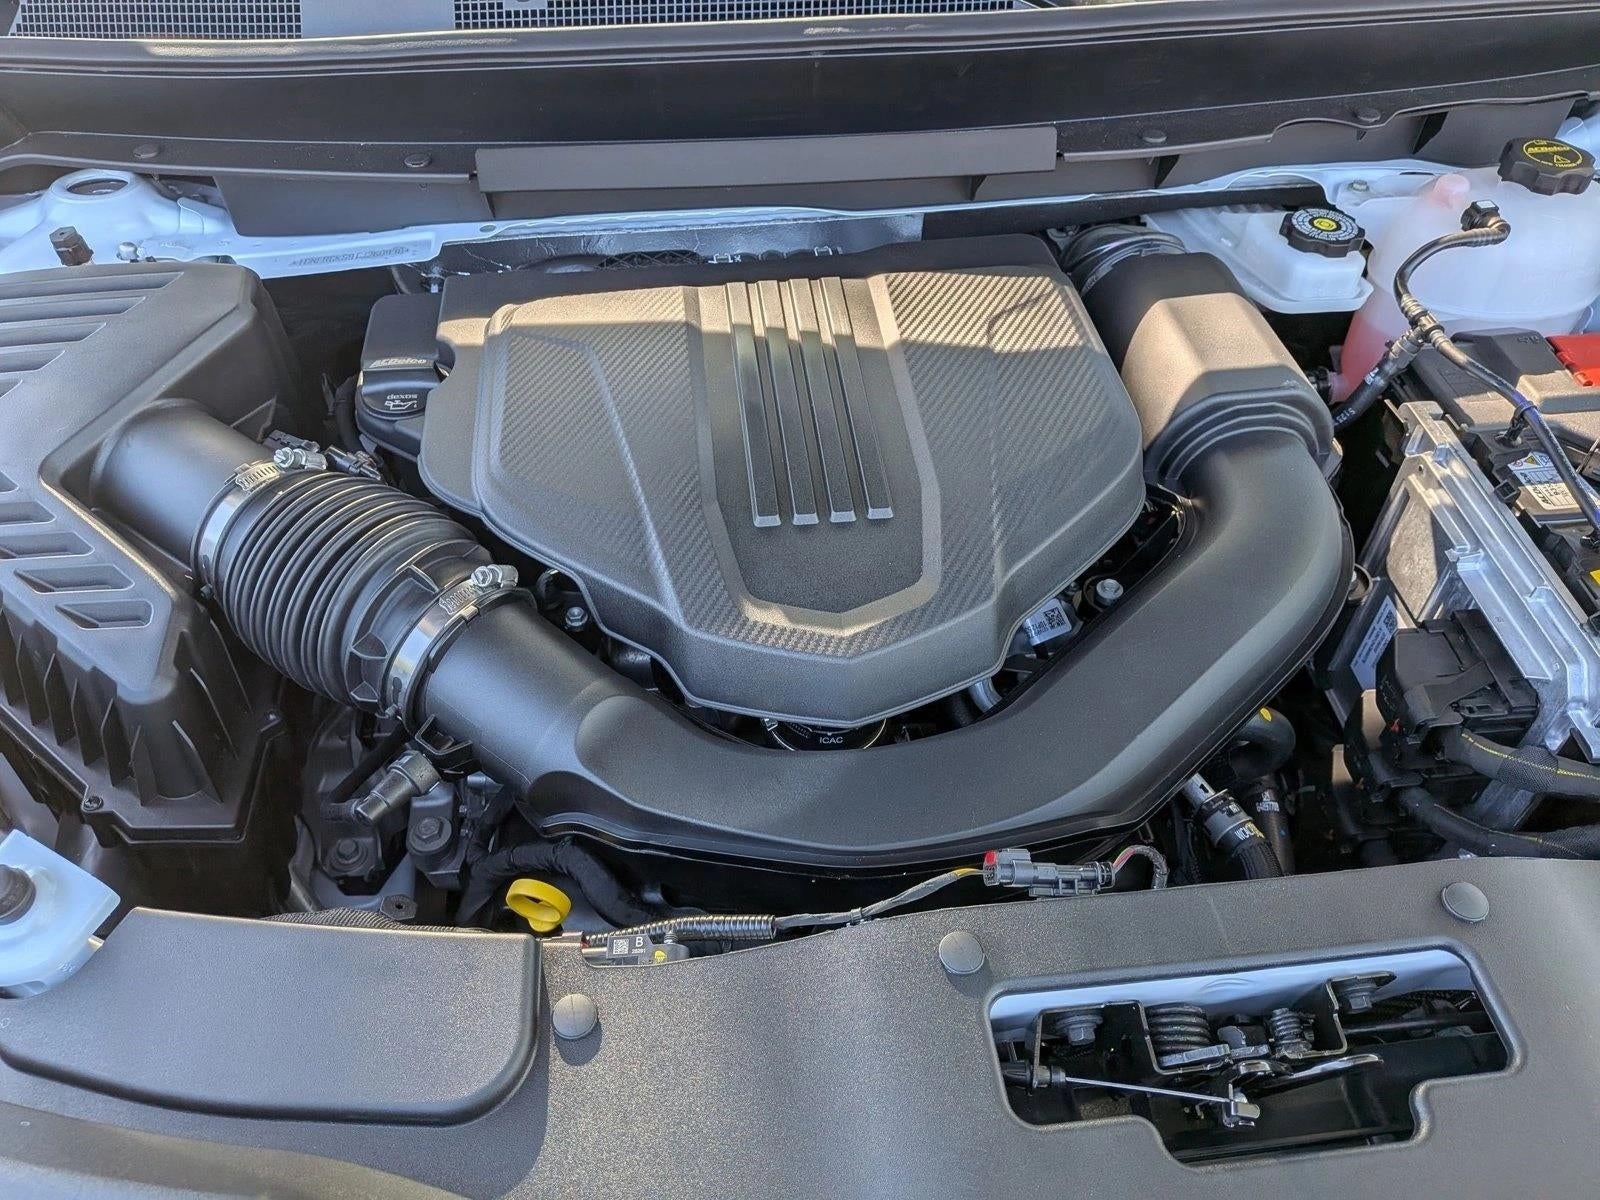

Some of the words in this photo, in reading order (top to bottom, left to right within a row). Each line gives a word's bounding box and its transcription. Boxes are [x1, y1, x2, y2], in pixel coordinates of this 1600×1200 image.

[1527, 146, 1570, 154] ACDelco
[369, 357, 427, 368] ACDelco
[819, 736, 844, 745] ICAC
[635, 936, 645, 948] B
